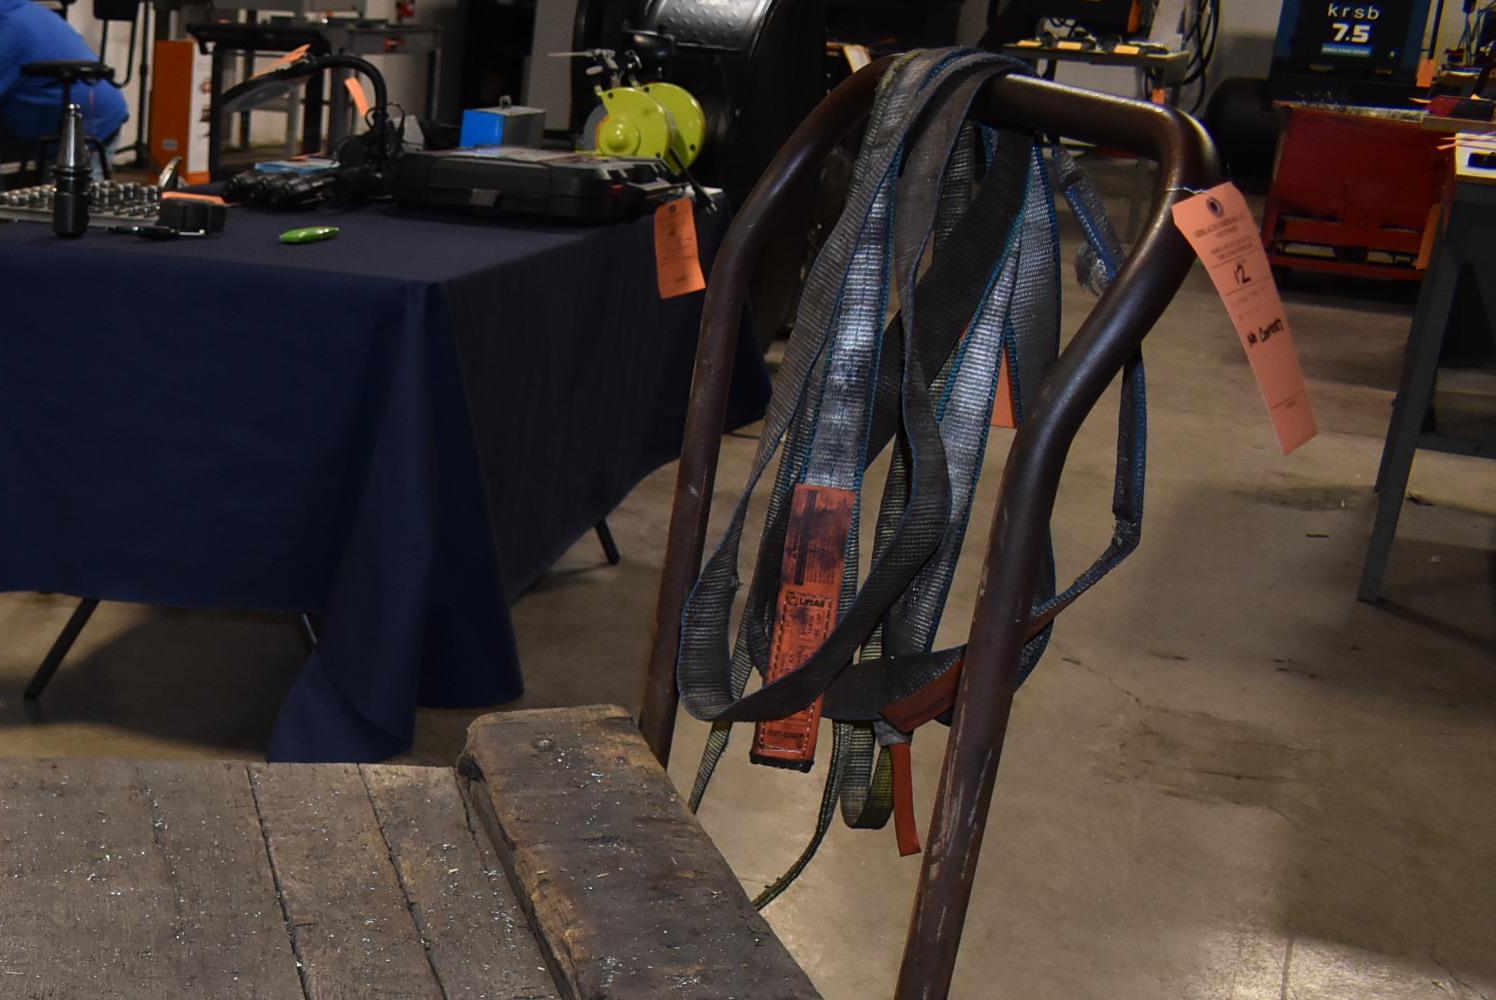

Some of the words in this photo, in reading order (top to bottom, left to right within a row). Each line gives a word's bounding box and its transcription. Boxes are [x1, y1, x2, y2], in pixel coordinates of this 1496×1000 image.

[1327, 3, 1379, 20] krsb
[1331, 22, 1371, 44] 7.5
[1233, 264, 1252, 286] 12
